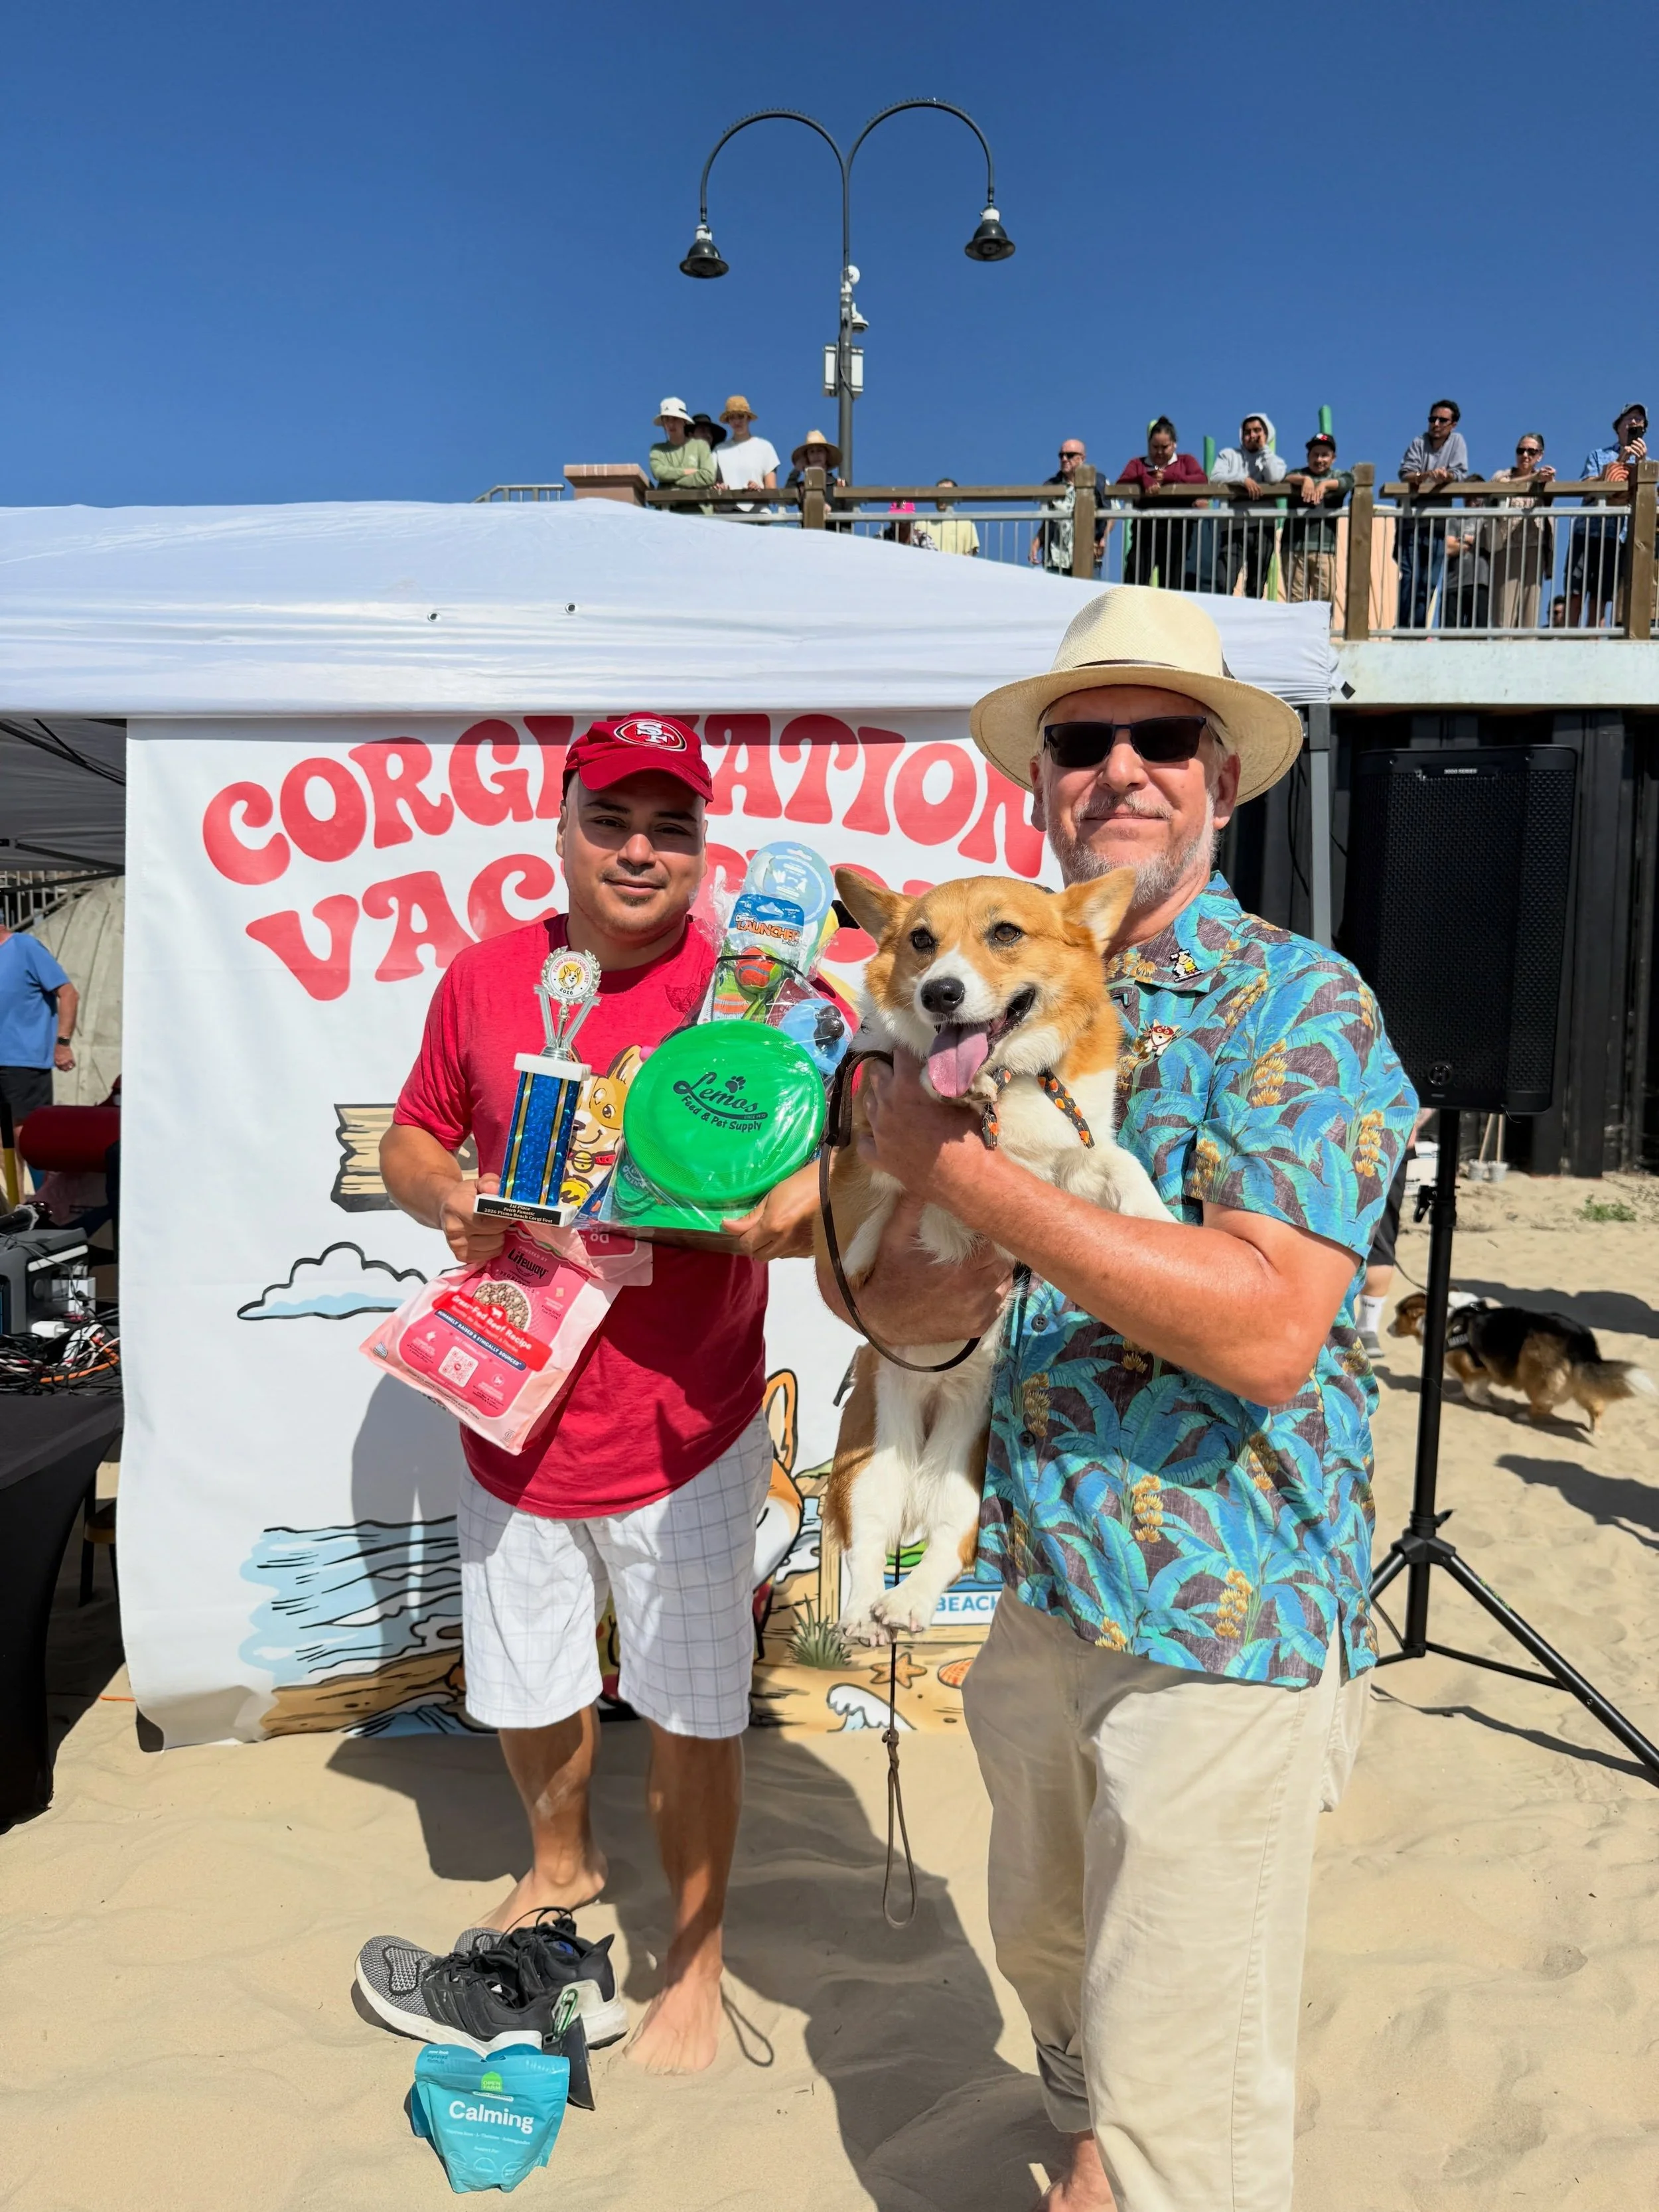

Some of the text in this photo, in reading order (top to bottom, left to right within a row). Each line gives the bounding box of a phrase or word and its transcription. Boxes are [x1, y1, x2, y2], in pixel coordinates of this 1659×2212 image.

[202, 713, 1046, 885] CORGI ATION
[673, 1071, 760, 1114] Lemos
[682, 1095, 762, 1134] Feed & Pet Supply
[516, 1208, 536, 1217] Fanatic
[507, 1248, 547, 1280] Lifeway
[458, 1322, 474, 1337] RAISED
[476, 1335, 499, 1354] ETHICALLY
[486, 1317, 506, 1332] Beef
[505, 1329, 532, 1350] Recipe
[449, 2100, 535, 2135] Calming
